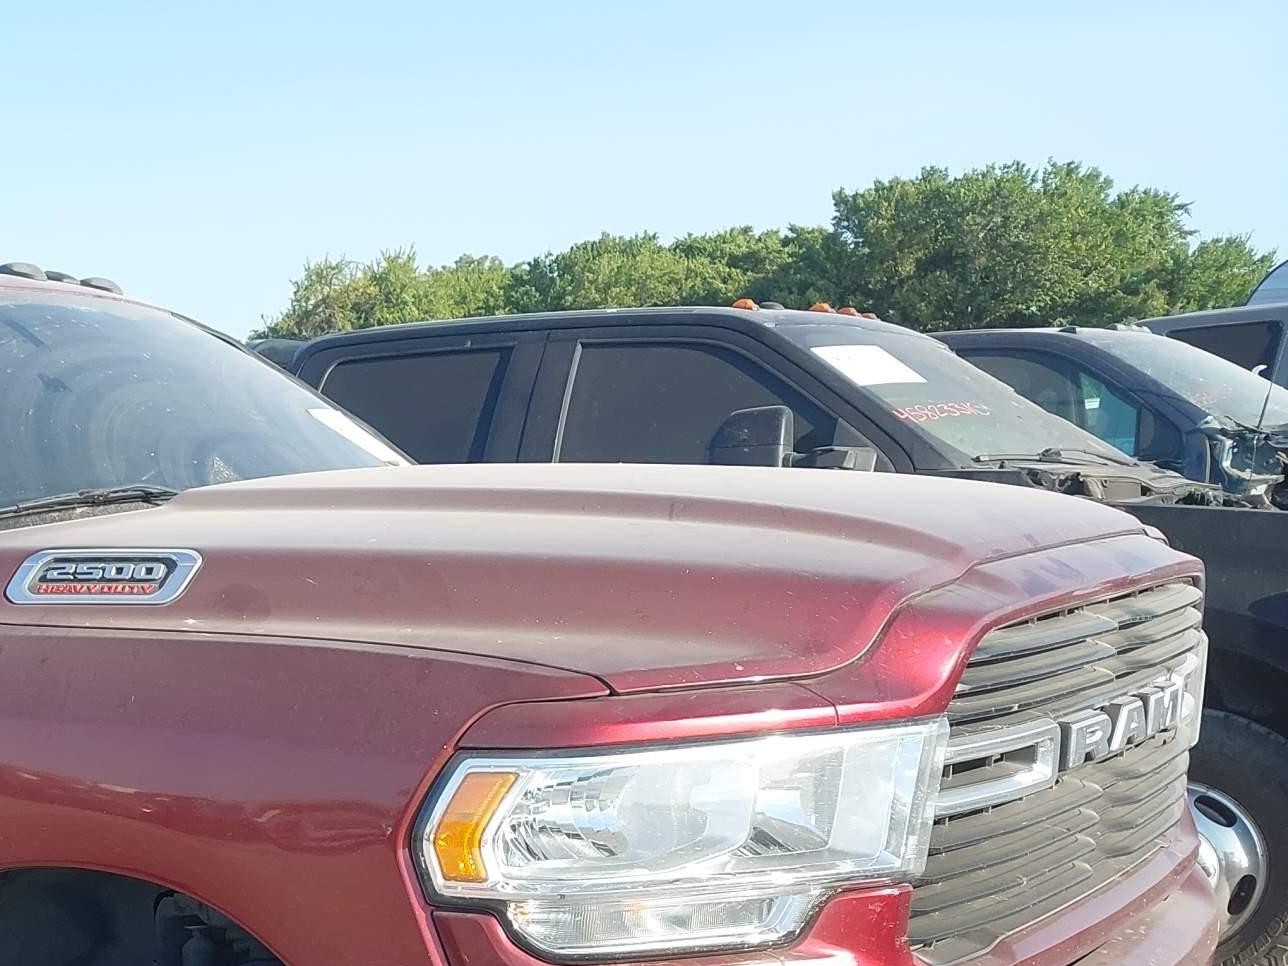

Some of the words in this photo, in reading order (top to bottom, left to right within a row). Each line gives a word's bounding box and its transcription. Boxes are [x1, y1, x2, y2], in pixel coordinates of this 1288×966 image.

[43, 563, 168, 581] 2500
[37, 583, 100, 594] HEAVY
[100, 583, 155, 594] DUTY
[1060, 677, 1180, 770] RAM
